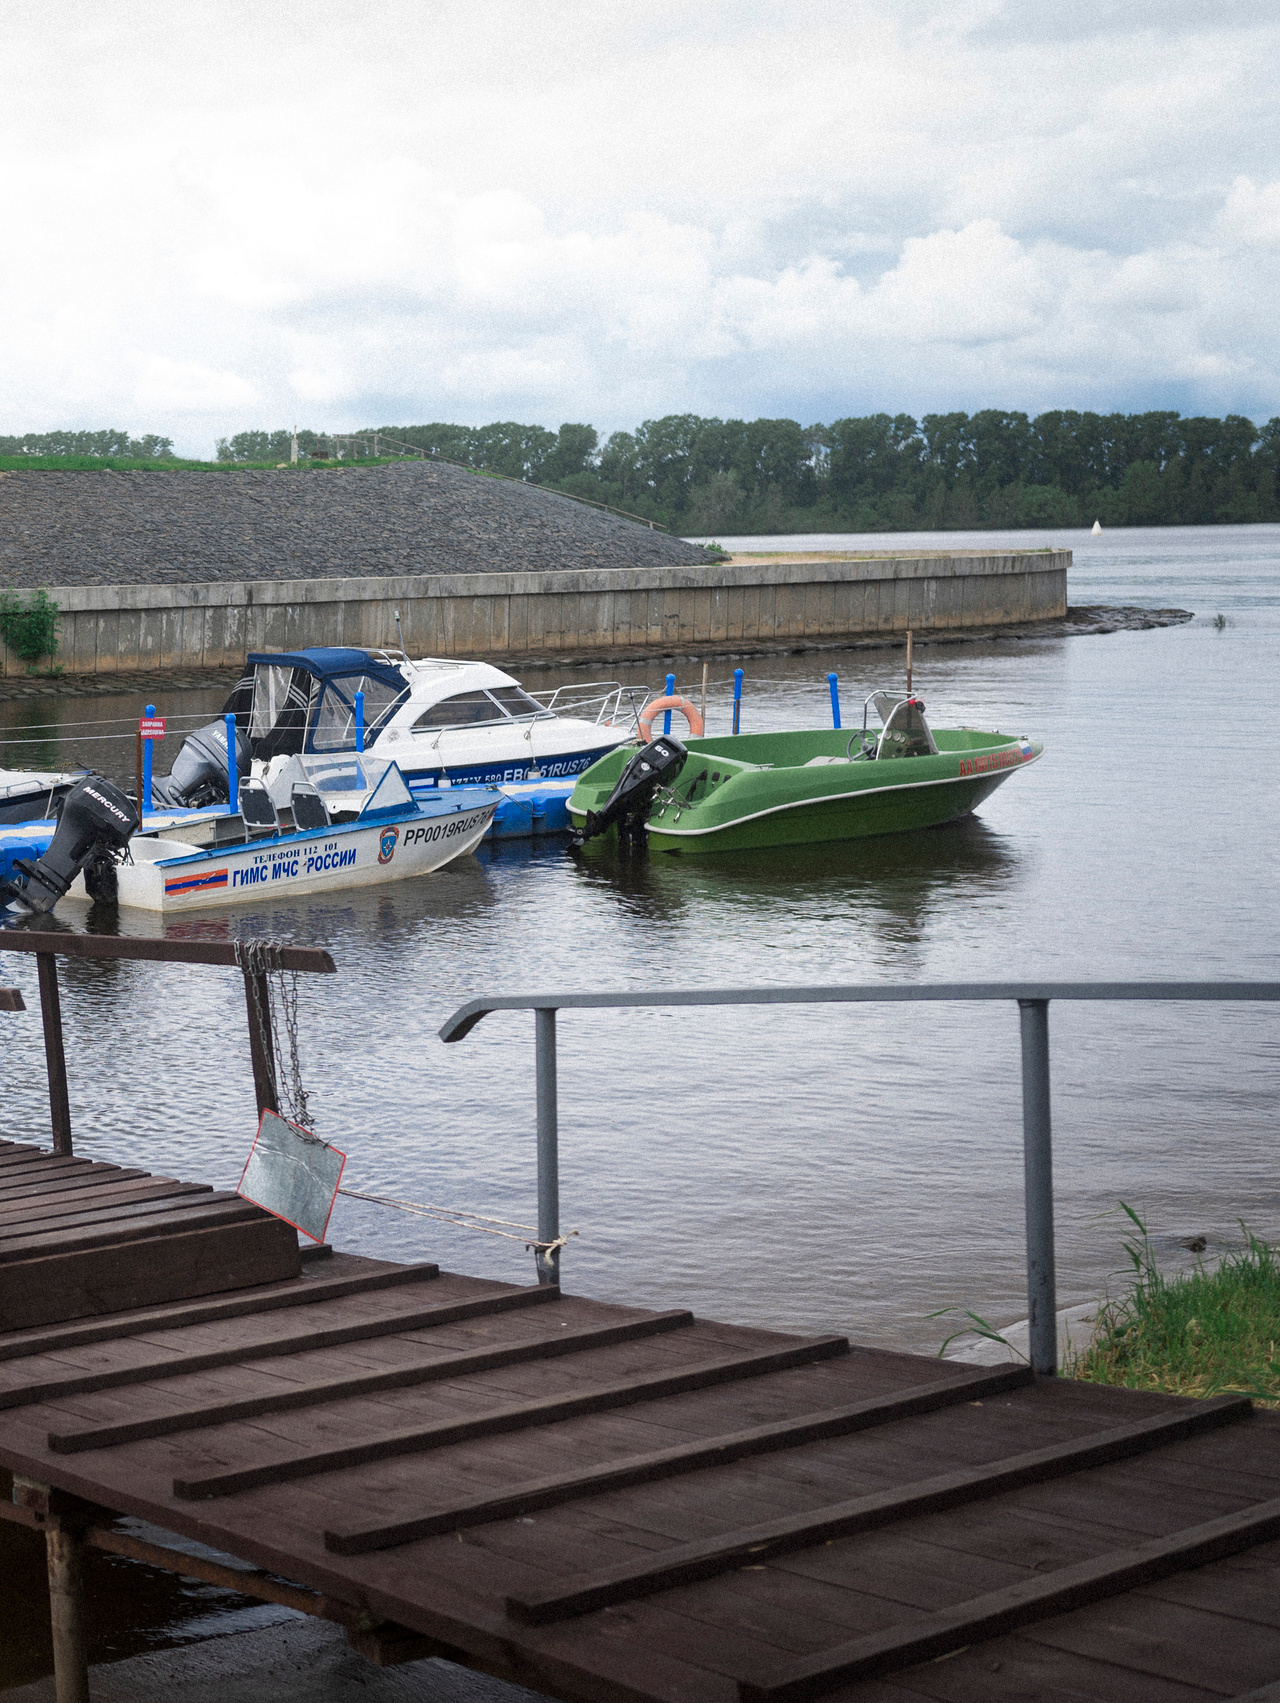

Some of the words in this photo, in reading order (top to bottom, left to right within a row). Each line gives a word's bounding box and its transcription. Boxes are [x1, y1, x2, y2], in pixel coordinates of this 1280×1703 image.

[654, 745, 670, 757] 60
[82, 786, 131, 822] MERCURY
[232, 864, 268, 887] ГИМС
[272, 860, 299, 880] МЧС
[306, 848, 357, 873] РОССИИ
[253, 848, 300, 864] ТЕЛЕФОН
[303, 846, 318, 856] 112
[324, 842, 338, 852] 101
